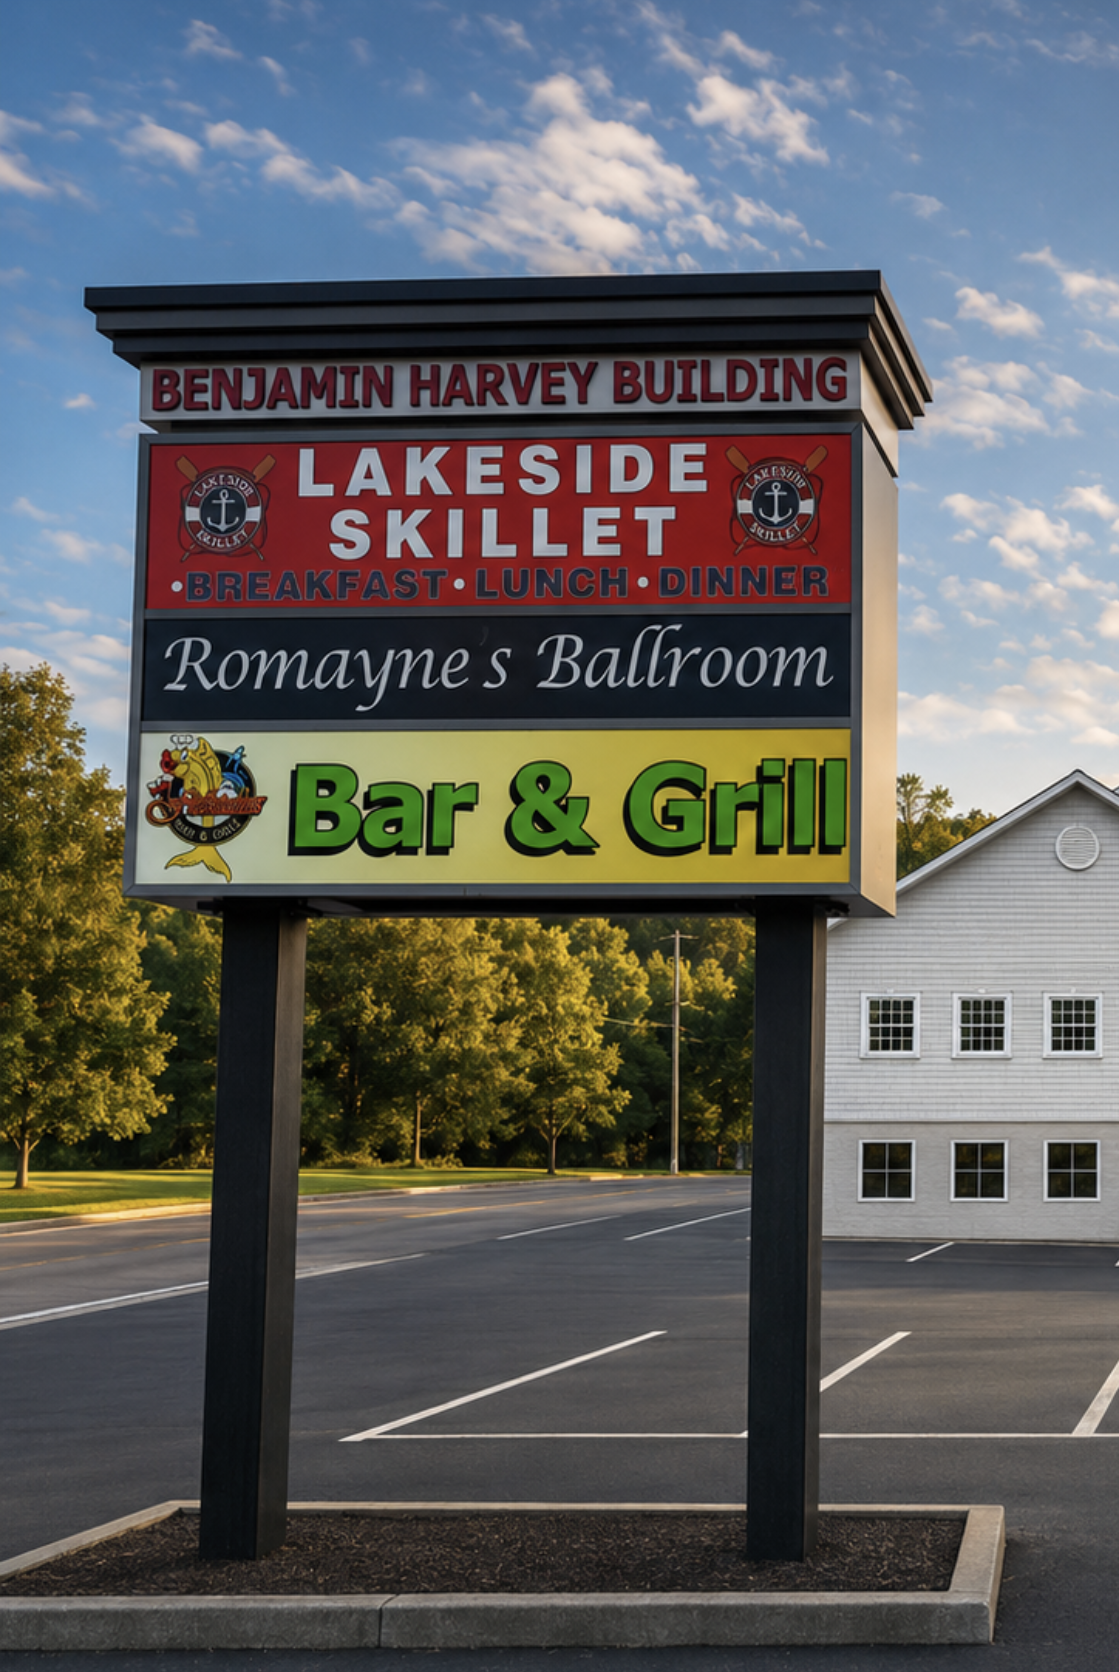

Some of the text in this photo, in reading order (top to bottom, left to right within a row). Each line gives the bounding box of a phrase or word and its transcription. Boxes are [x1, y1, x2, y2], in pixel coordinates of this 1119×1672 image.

[152, 357, 849, 411] BENJAMIN HARVEY BUILDING
[298, 443, 708, 497] LAKESIDE
[329, 505, 676, 560] SKILLET
[185, 566, 829, 602] BREAKFAST LUNCH DINNER
[536, 623, 834, 688] Ballroom
[287, 758, 848, 857] Bar & Grill
